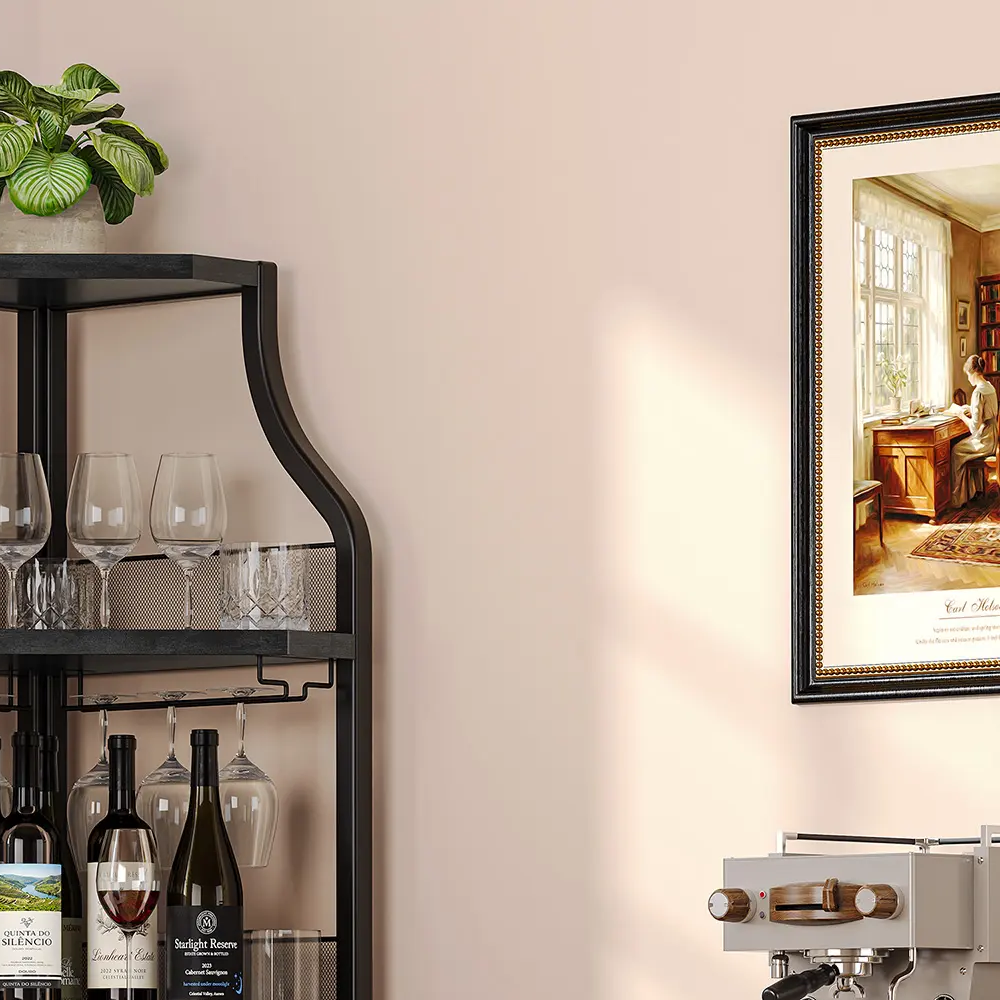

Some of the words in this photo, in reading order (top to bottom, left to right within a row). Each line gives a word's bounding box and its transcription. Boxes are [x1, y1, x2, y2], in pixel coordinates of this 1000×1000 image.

[971, 597, 1000, 613] Helso
[1, 937, 53, 946] SILÊNCIO
[174, 938, 208, 951] Starlight
[210, 938, 238, 949] Reserve
[91, 948, 132, 961] Lionhear
